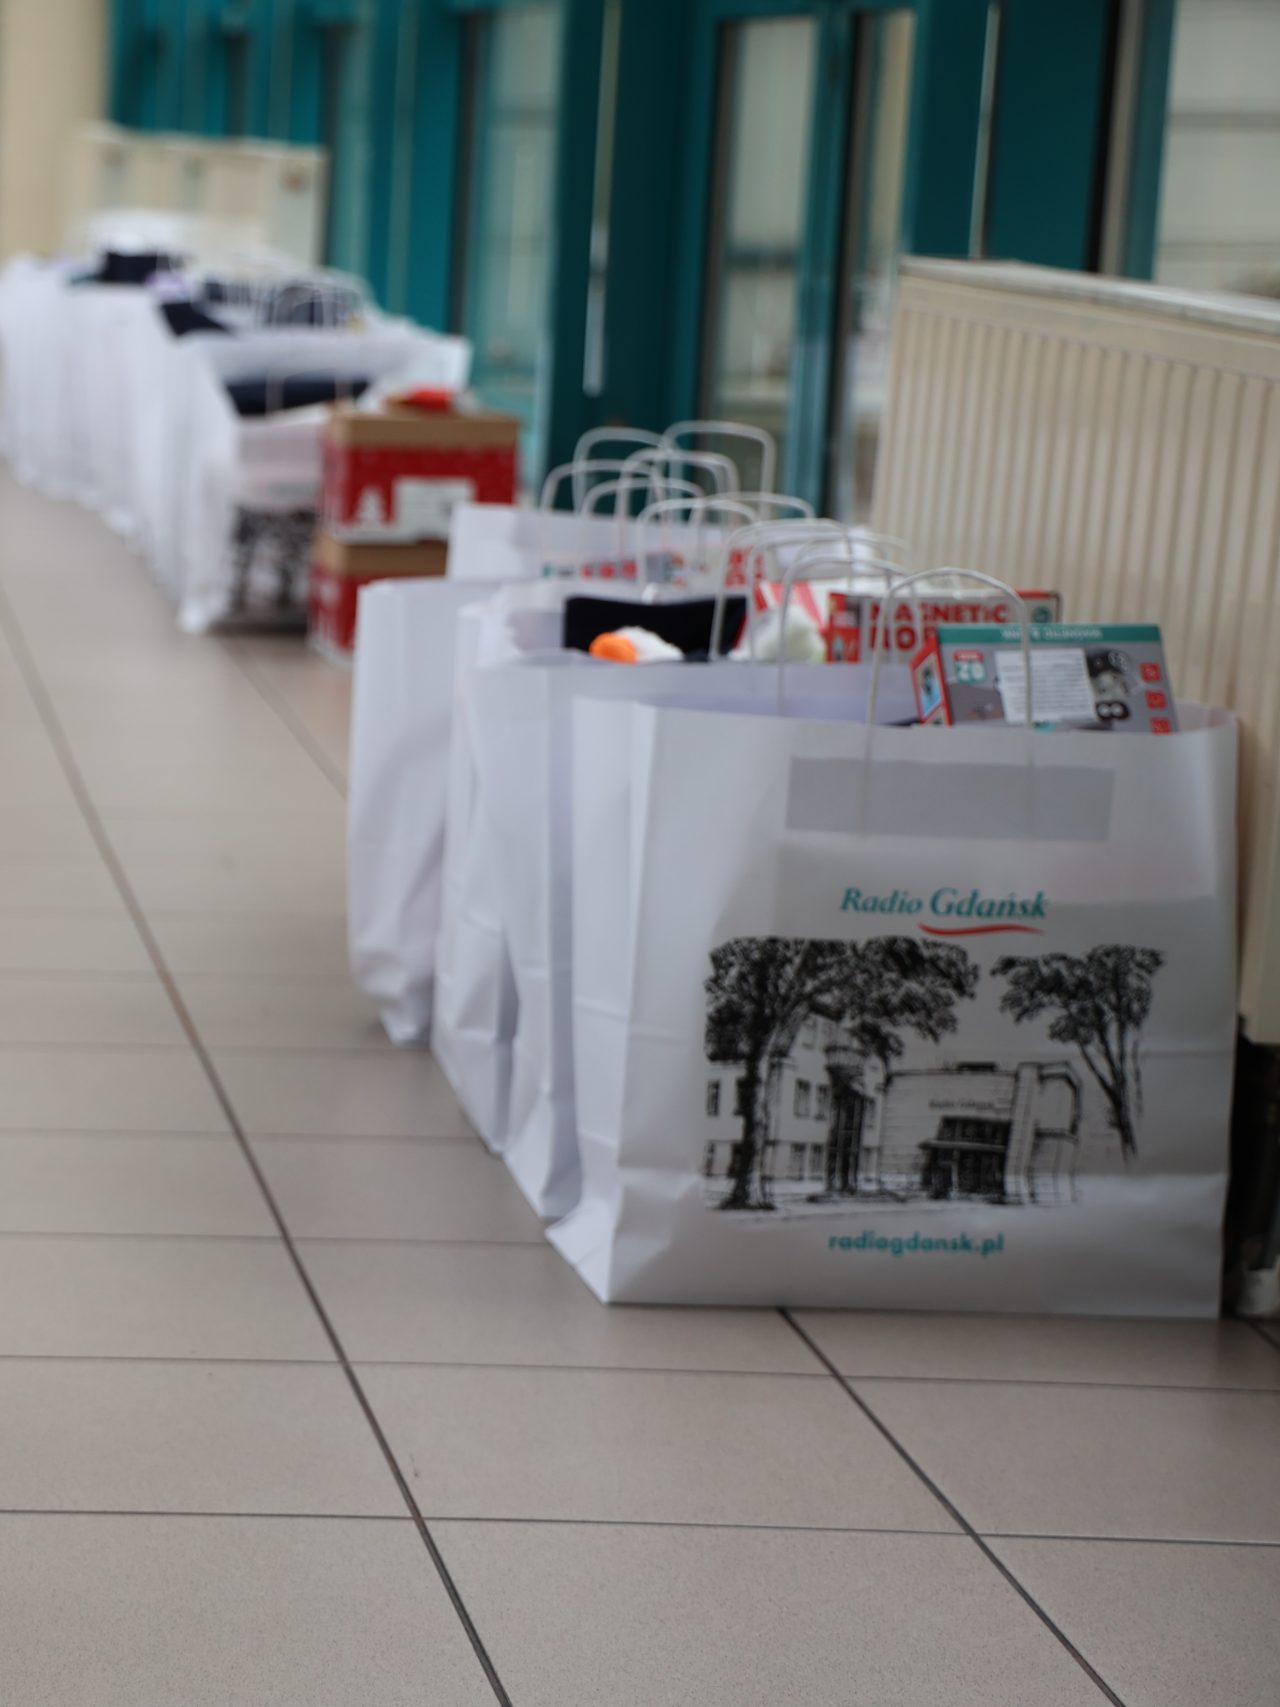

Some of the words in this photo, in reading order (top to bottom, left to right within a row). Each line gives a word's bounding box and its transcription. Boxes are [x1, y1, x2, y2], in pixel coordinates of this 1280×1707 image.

[840, 886, 924, 914] Radio
[929, 886, 1049, 918] Gdańsk
[827, 1230, 1006, 1258] radiogdansk.pl
